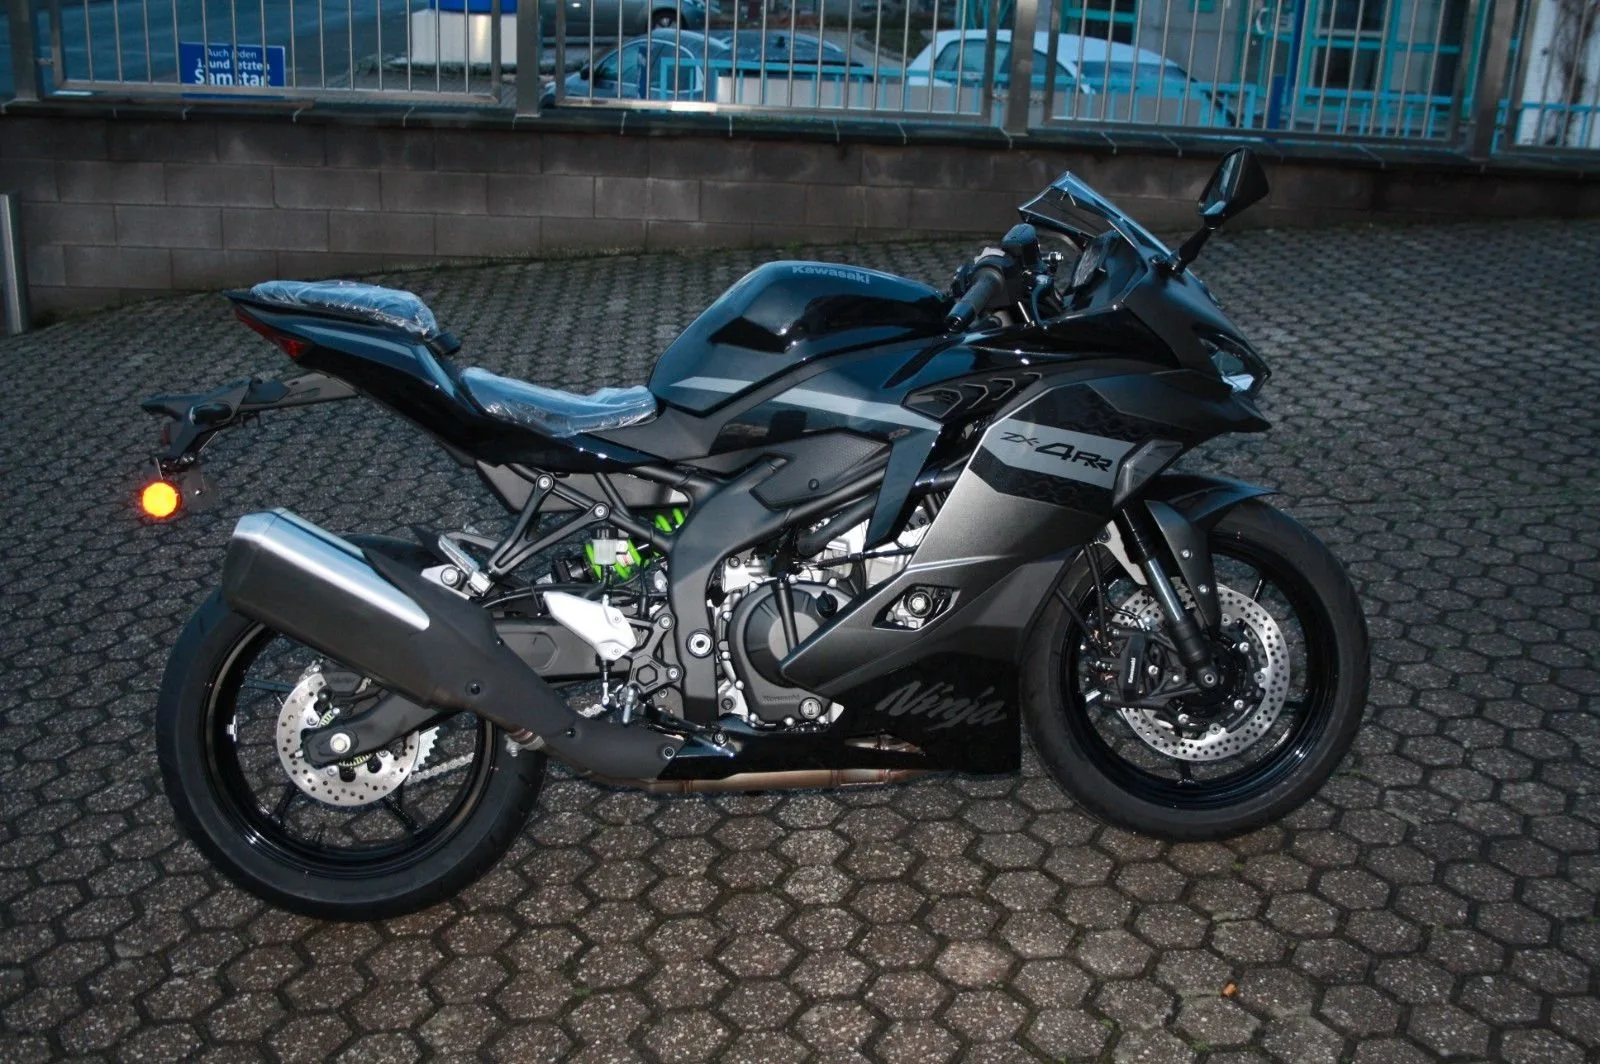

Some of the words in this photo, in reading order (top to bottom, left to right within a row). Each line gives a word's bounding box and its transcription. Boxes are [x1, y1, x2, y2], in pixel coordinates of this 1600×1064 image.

[231, 49, 257, 59] jden
[209, 59, 230, 69] und
[792, 265, 870, 285] Kawasaki
[875, 680, 1007, 732] Ninja
